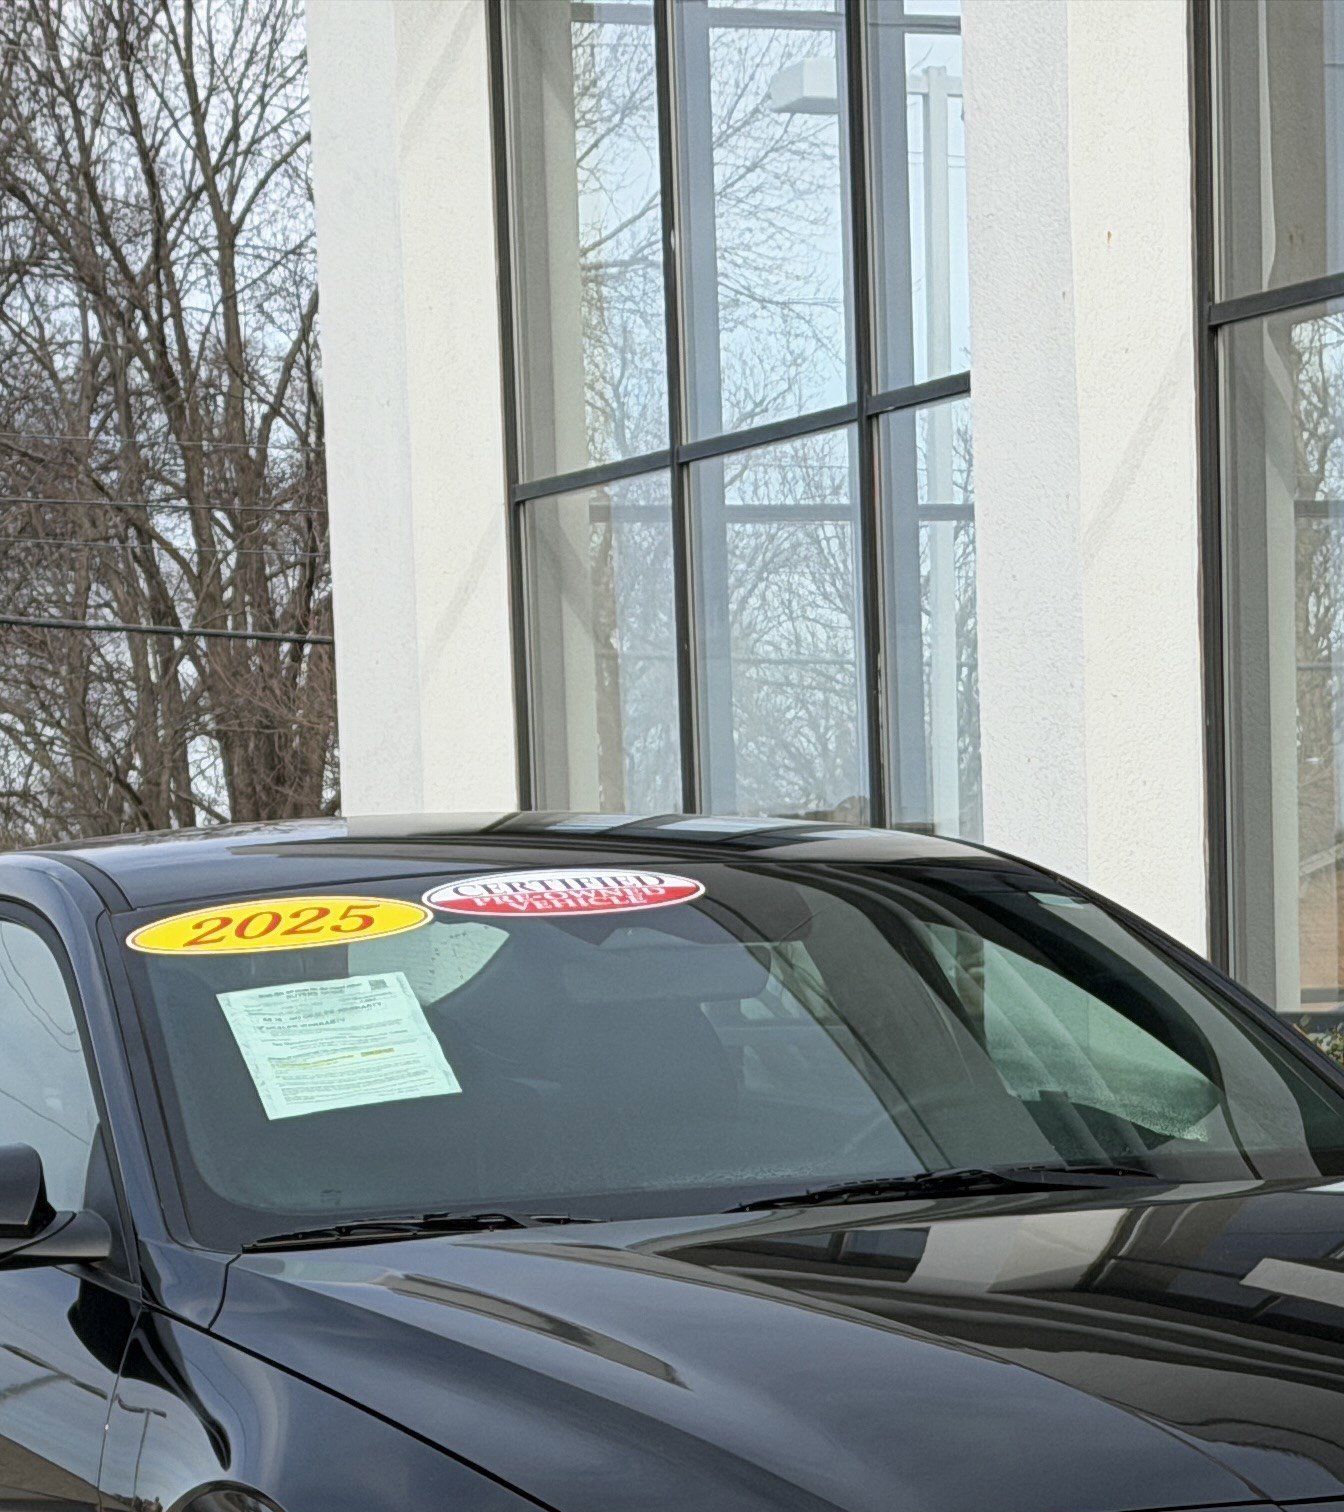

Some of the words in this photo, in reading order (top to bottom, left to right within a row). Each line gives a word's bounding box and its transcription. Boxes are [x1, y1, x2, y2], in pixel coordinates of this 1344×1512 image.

[453, 873, 666, 897] CERTIFIED
[472, 886, 666, 907] PRE-OWNED
[506, 895, 648, 911] VEHICLE
[182, 904, 380, 947] 2025
